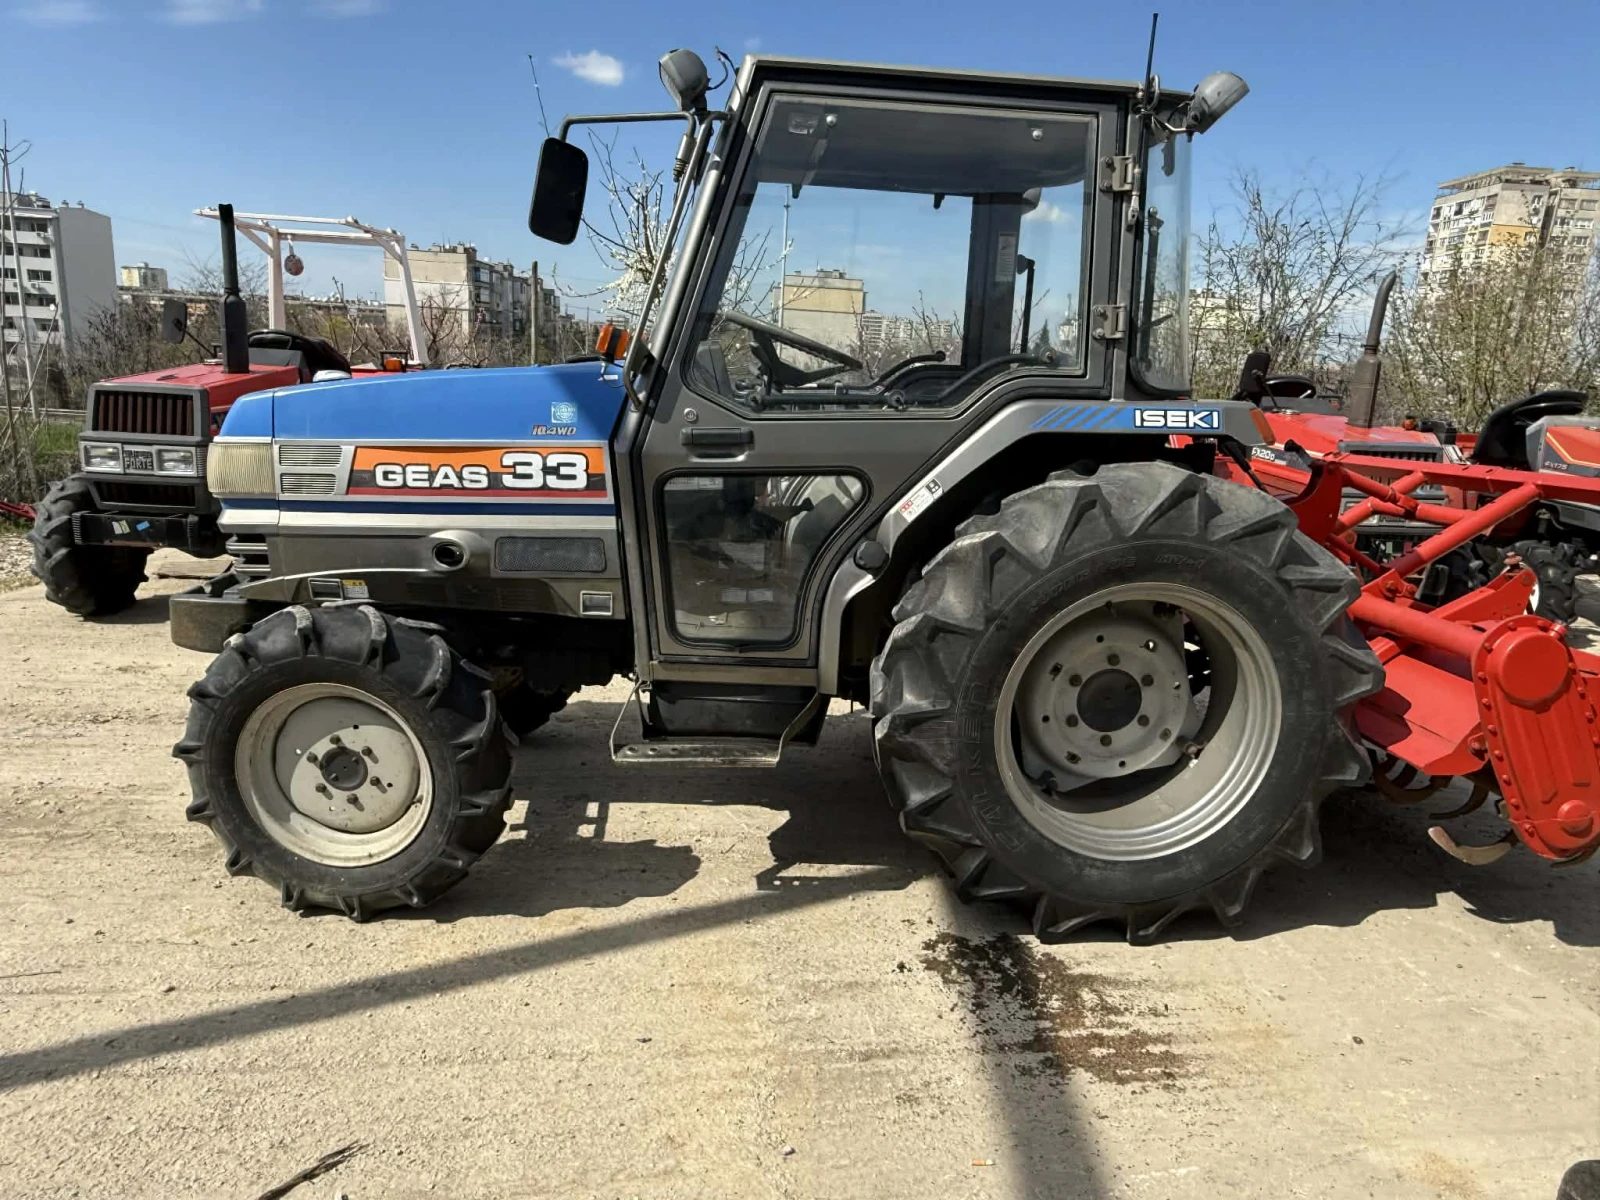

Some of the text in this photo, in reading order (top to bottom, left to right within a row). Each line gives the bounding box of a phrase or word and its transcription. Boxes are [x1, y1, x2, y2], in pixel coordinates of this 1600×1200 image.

[1134, 409, 1219, 428] ISEKI
[124, 457, 153, 470] FORTE
[374, 452, 588, 489] GEAS 33
